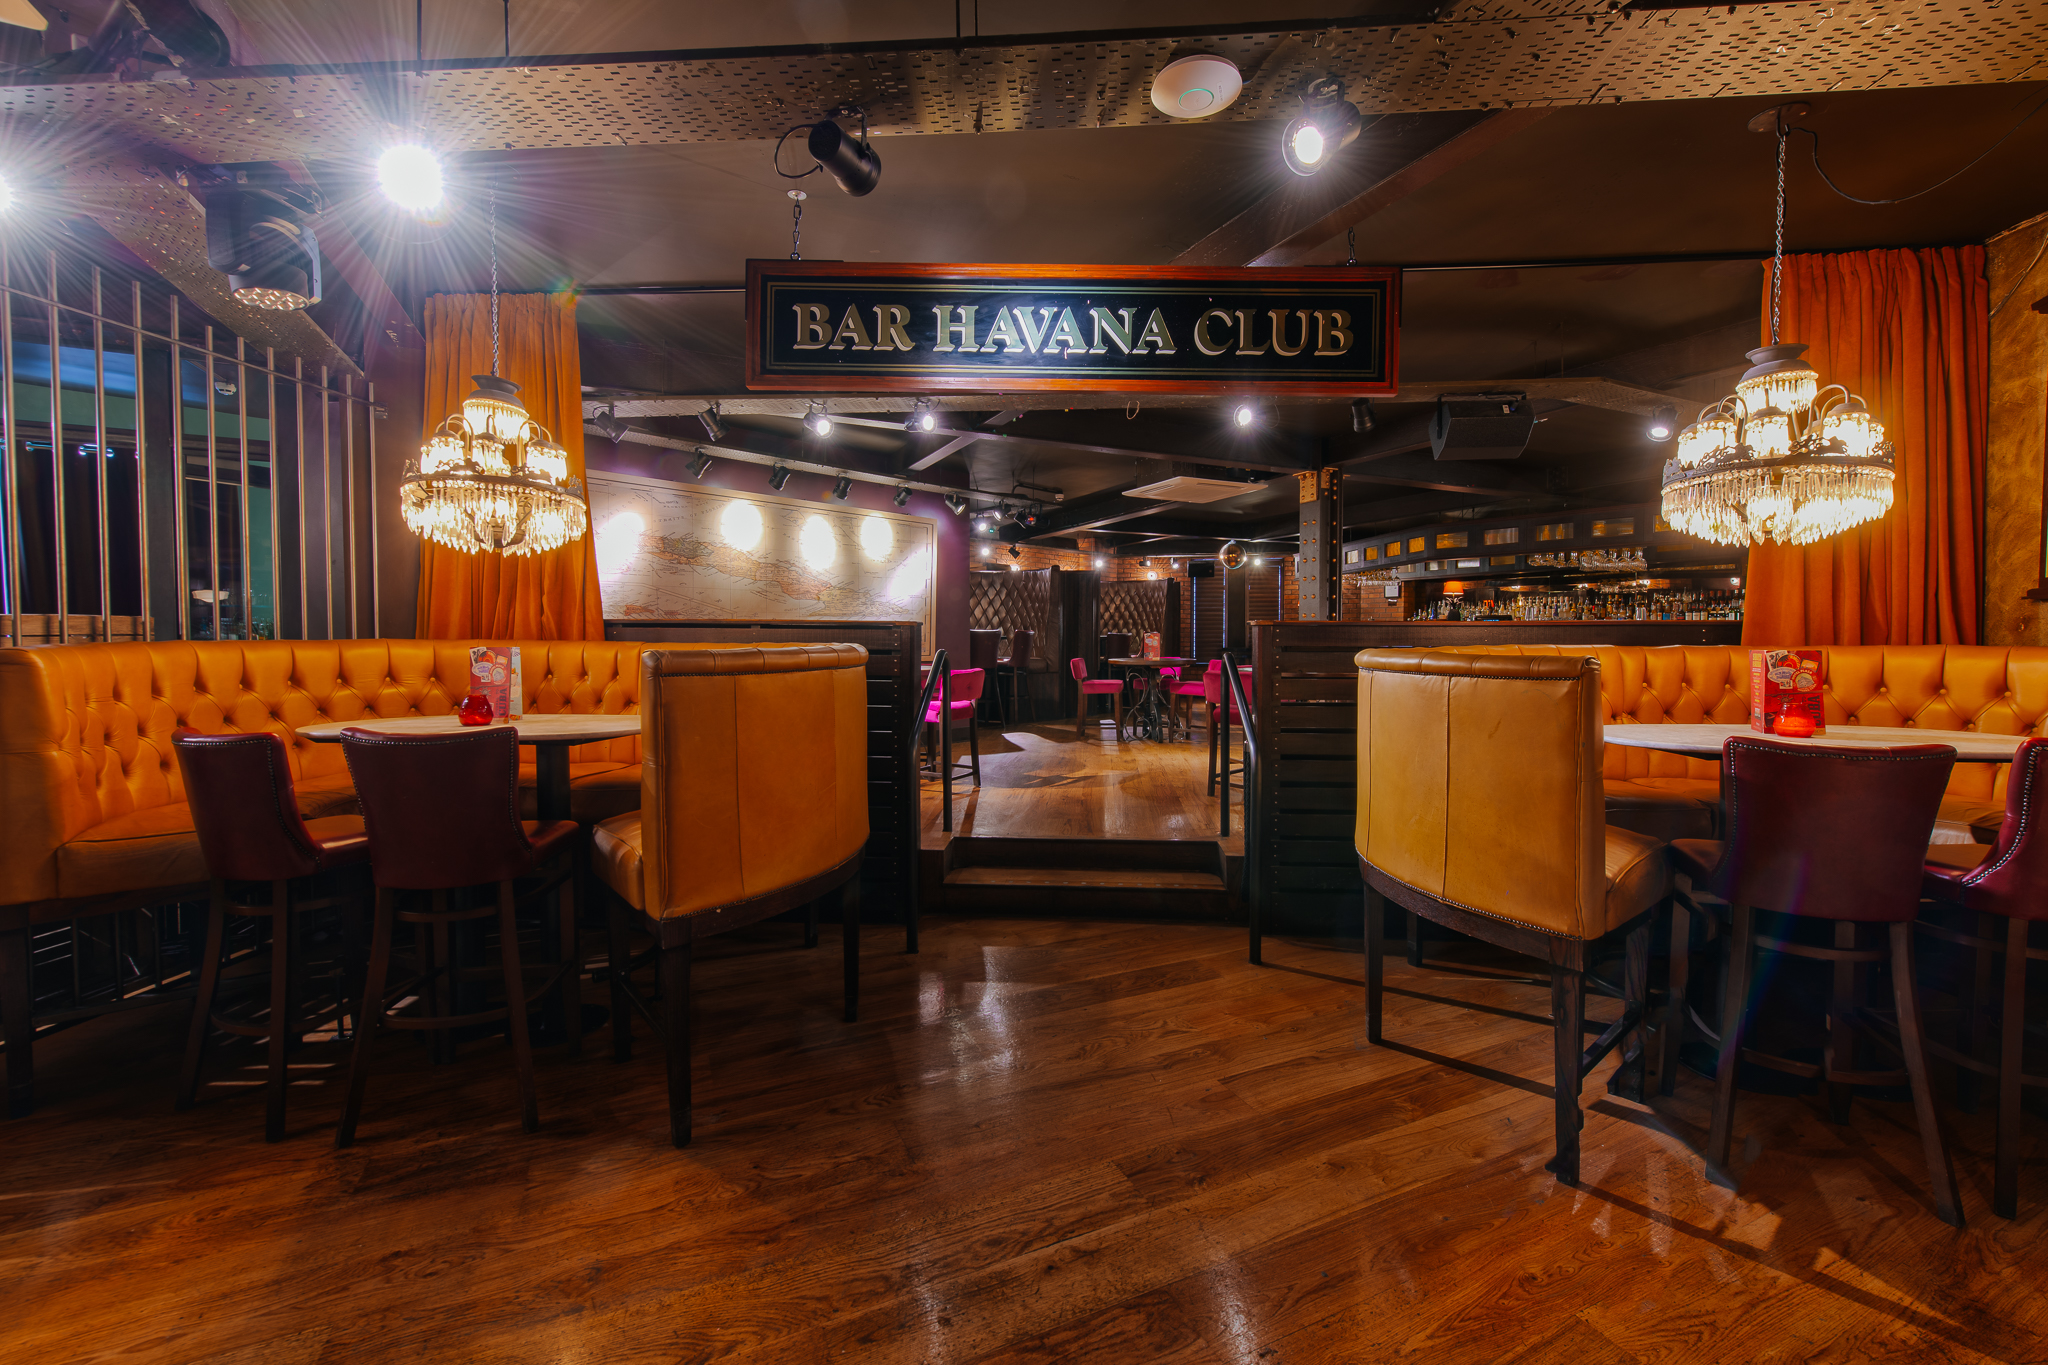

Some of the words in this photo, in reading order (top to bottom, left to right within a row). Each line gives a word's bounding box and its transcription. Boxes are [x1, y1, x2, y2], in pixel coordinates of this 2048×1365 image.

[792, 302, 916, 352] BAR
[931, 303, 1178, 355] HAVANA
[1192, 308, 1355, 358] CLUB
[499, 688, 507, 716] CUBA
